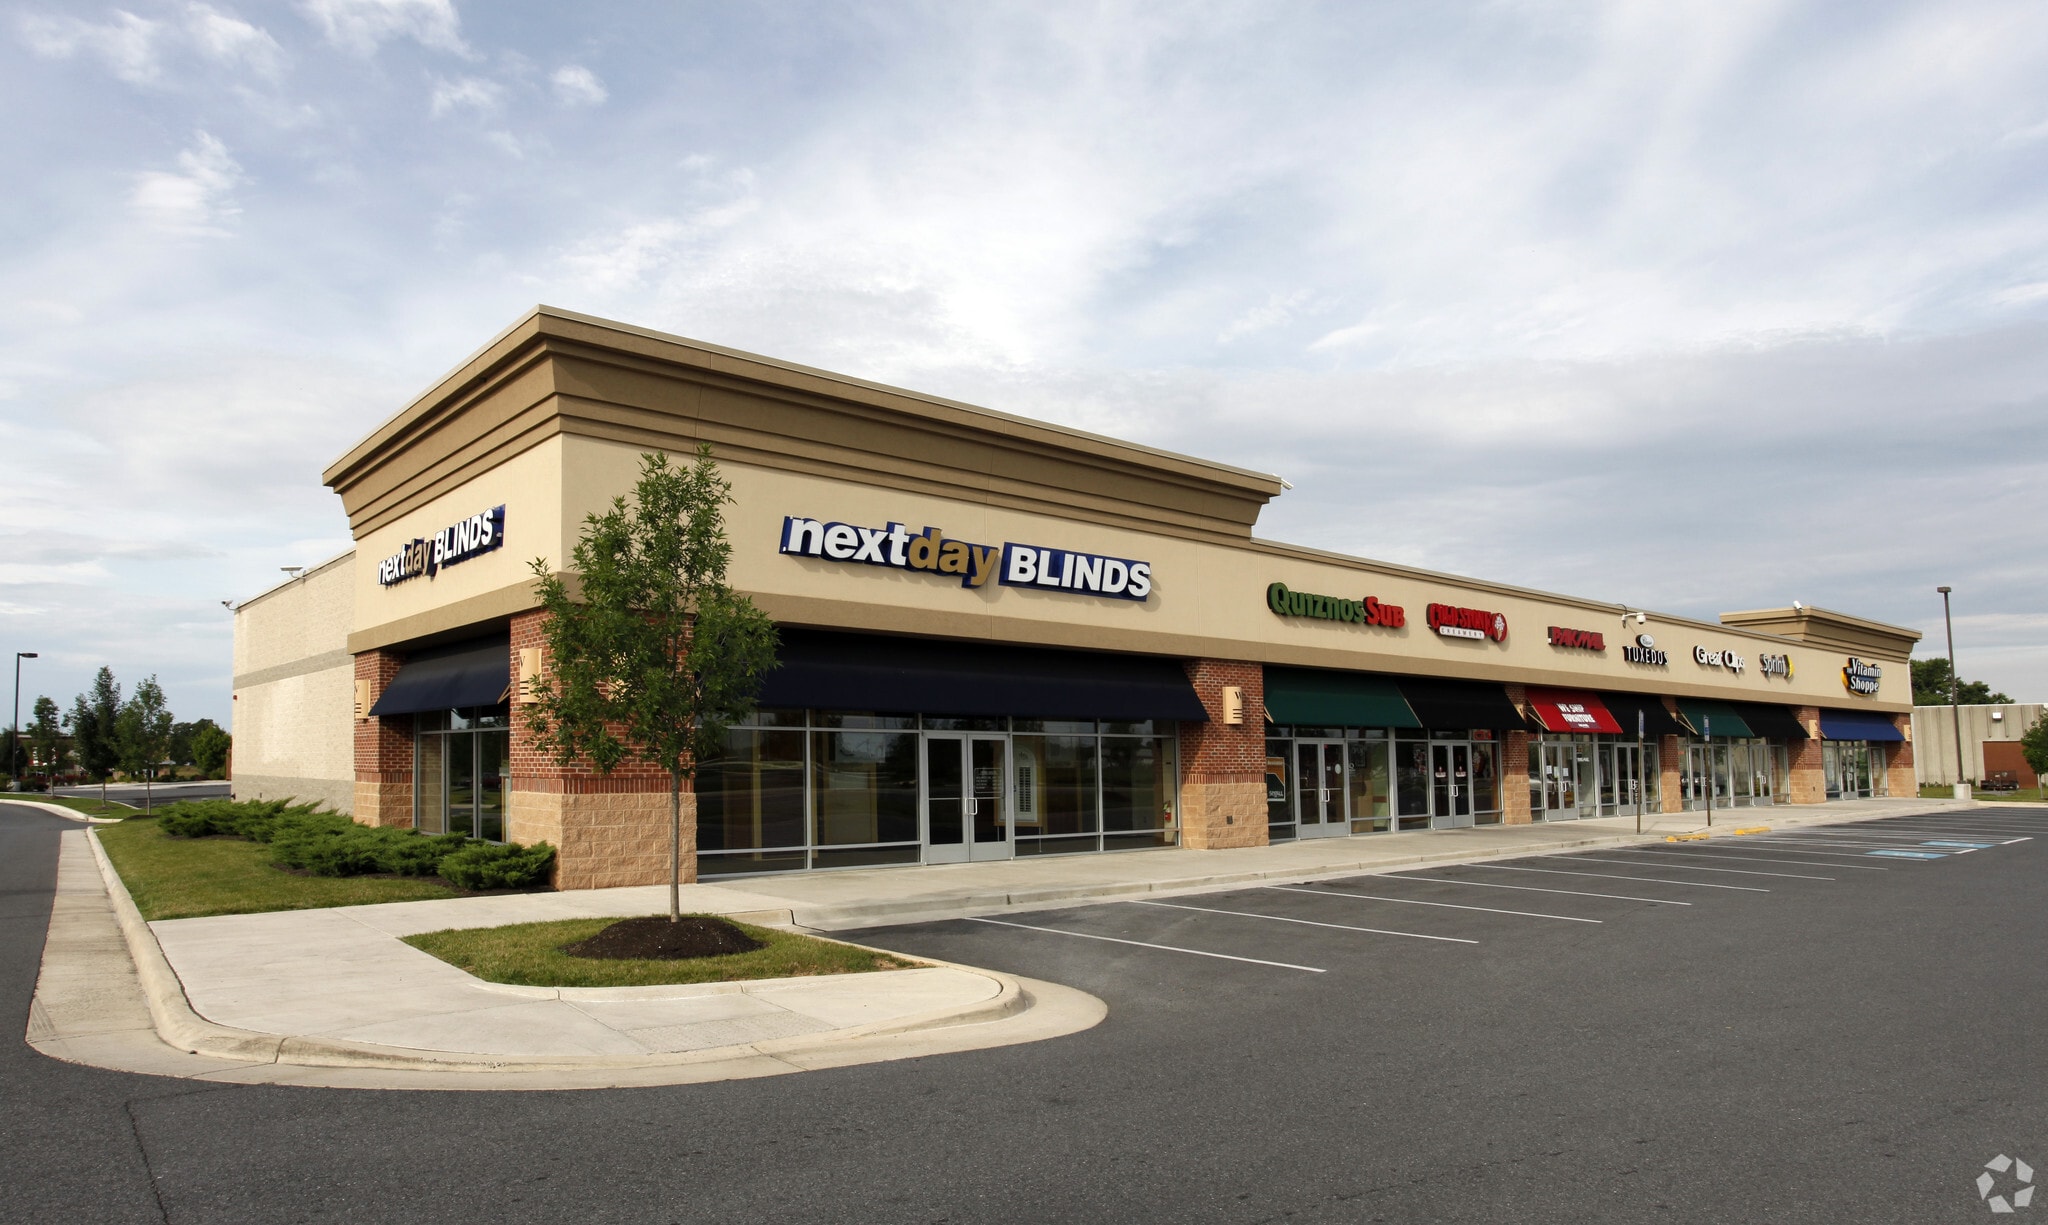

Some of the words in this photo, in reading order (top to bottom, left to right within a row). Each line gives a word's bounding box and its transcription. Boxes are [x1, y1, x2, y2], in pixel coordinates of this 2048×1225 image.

[378, 538, 431, 585] nextday
[434, 508, 494, 564] BLINDS
[788, 518, 999, 586] nextday
[1007, 545, 1151, 598] BLINDS
[1440, 628, 1483, 638] CREAMERY
[1626, 646, 1669, 665] TUXEDOS
[1696, 645, 1723, 666] Great
[1724, 649, 1745, 673] Clips
[1763, 654, 1787, 677] Sprint
[1852, 658, 1881, 678] Vitamin
[1850, 675, 1879, 694] Shoppe
